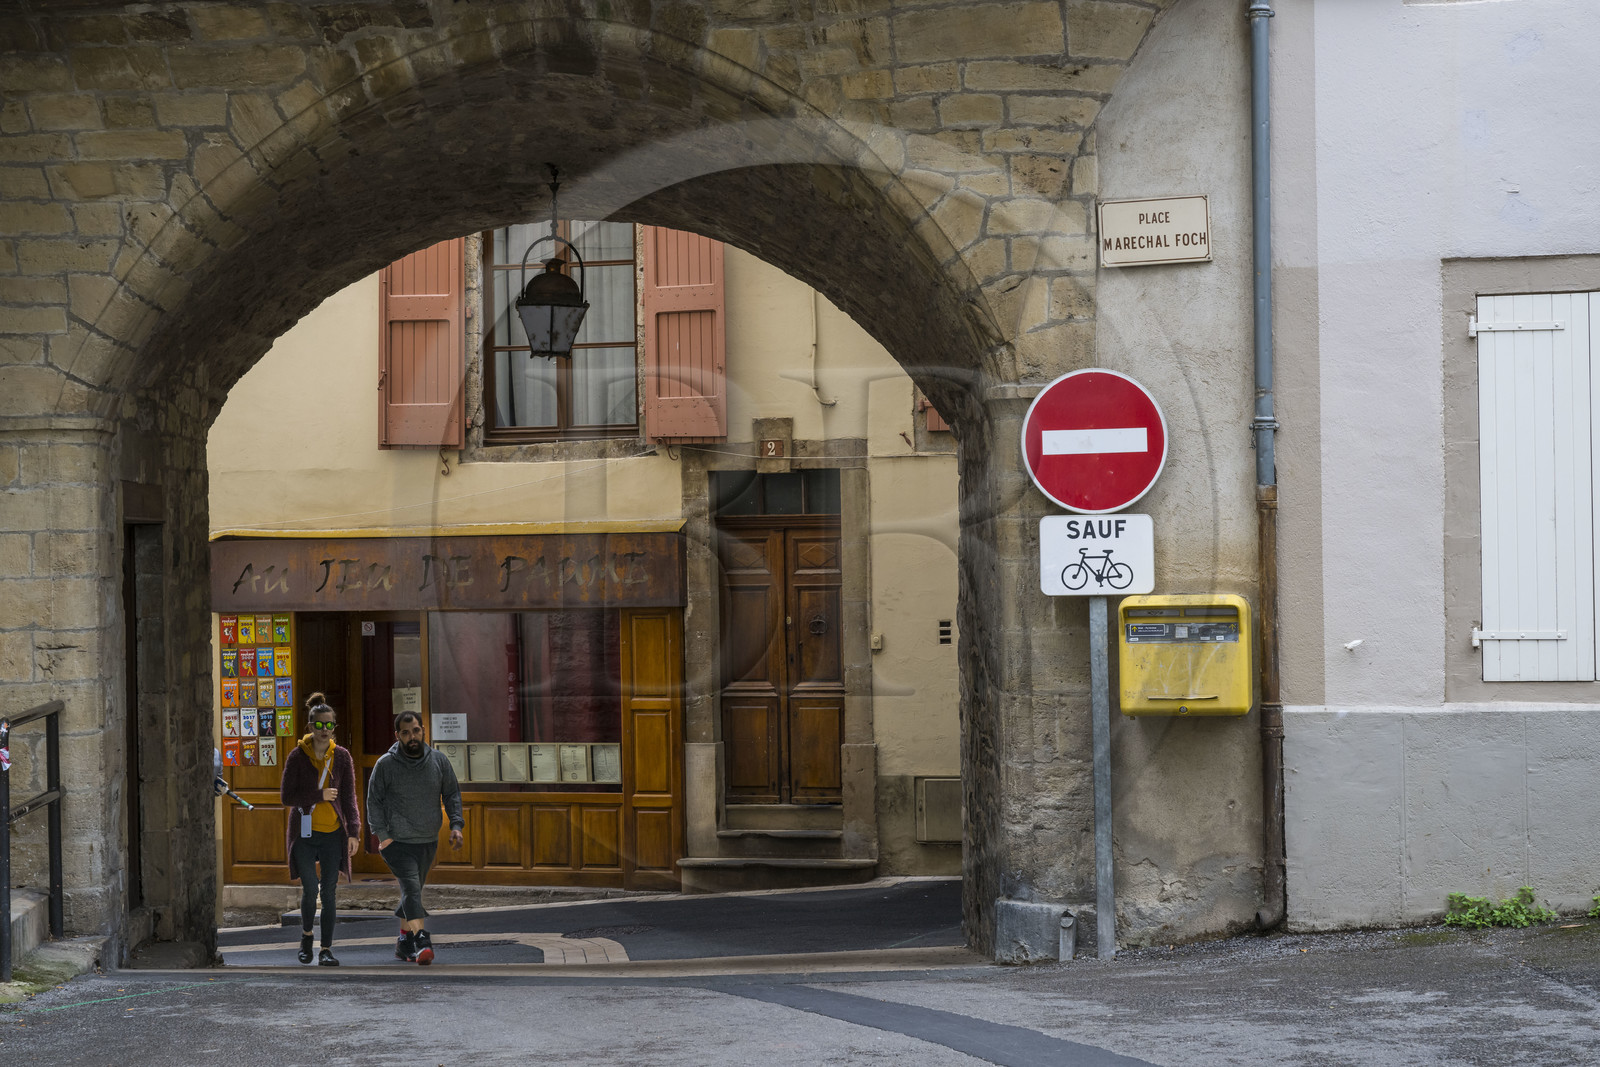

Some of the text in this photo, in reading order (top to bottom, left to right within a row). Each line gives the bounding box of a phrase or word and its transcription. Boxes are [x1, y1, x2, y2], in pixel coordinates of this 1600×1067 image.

[1138, 211, 1171, 225] PLACE
[1103, 231, 1207, 251] MARECHAL FOCH
[767, 441, 776, 456] 2
[1066, 519, 1127, 539] SAUF
[315, 558, 393, 594] JEU
[418, 554, 474, 592] DE
[500, 551, 649, 593] PAUME
